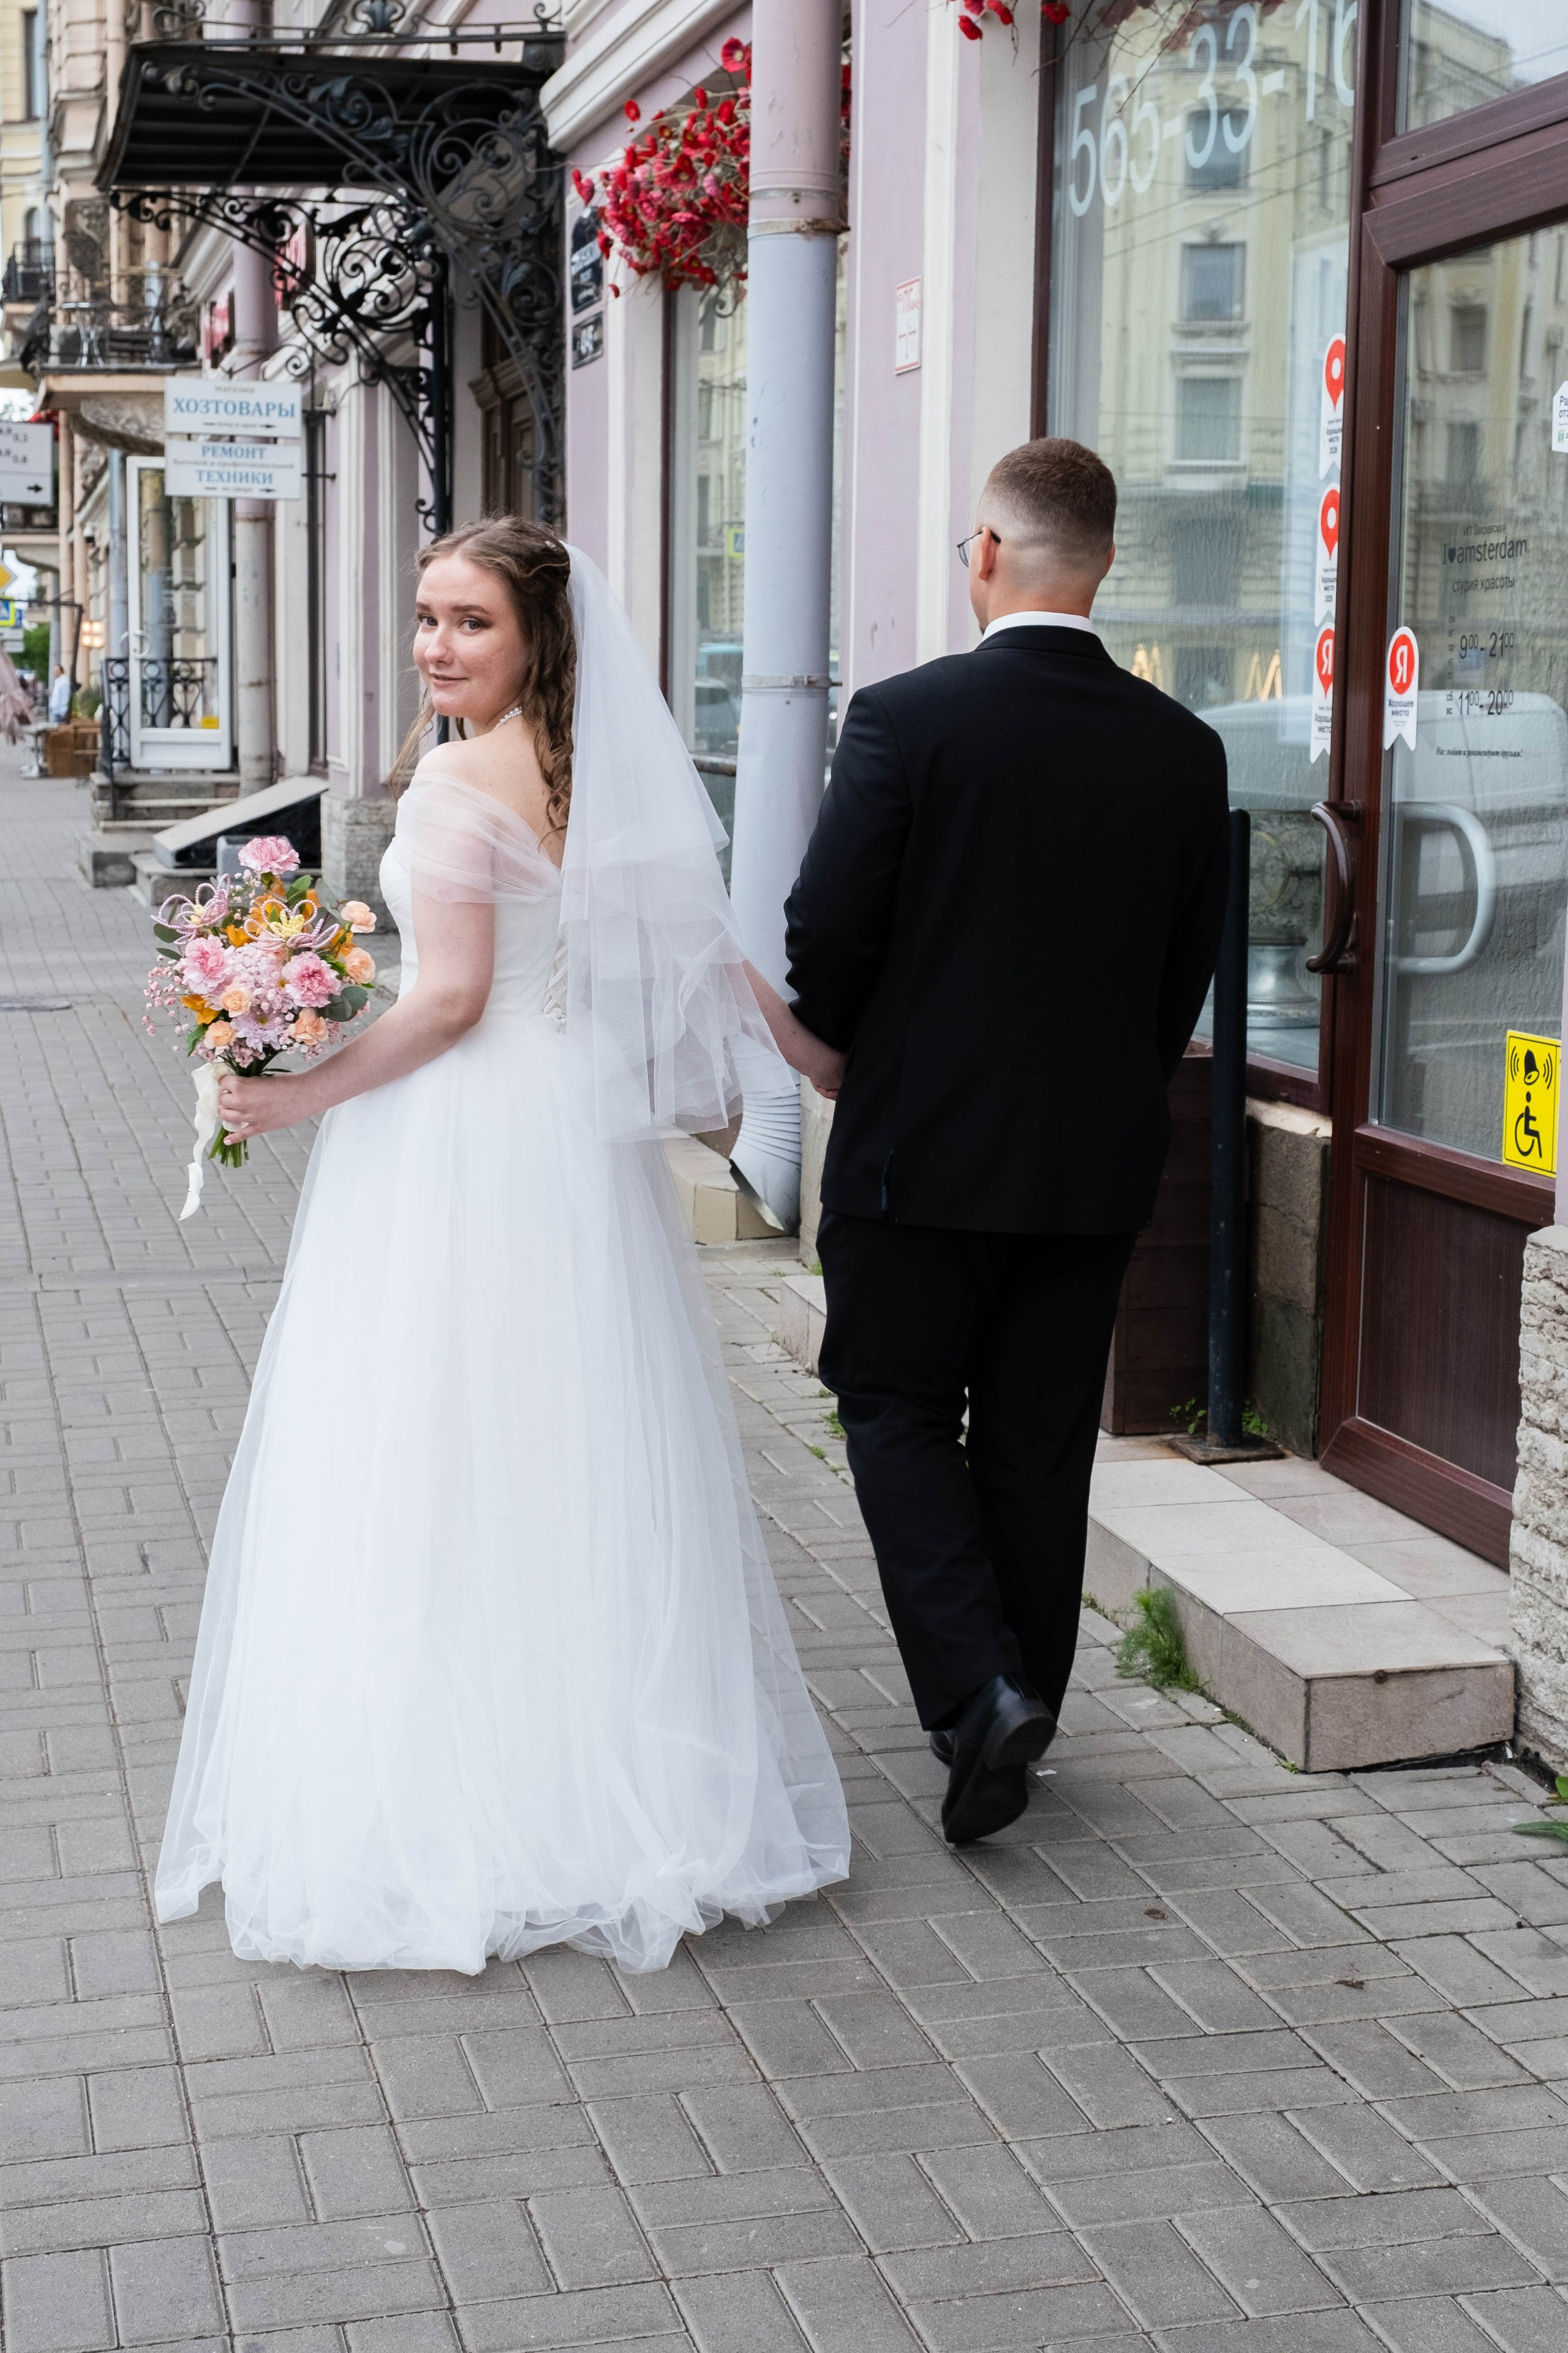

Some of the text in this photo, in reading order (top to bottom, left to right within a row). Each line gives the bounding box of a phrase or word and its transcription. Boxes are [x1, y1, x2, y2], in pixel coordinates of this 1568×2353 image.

[173, 397, 296, 418] ХОЗТОВАРЫ
[201, 445, 266, 459] РЕМОНТ
[195, 469, 274, 485] ТЕХНИКИ
[1457, 536, 1527, 564] amsterdam
[1480, 576, 1515, 593] красоты
[1321, 639, 1333, 675] Я
[1395, 645, 1408, 684] Я
[1388, 699, 1414, 708] Хорошее
[1314, 713, 1332, 723] Хорош
